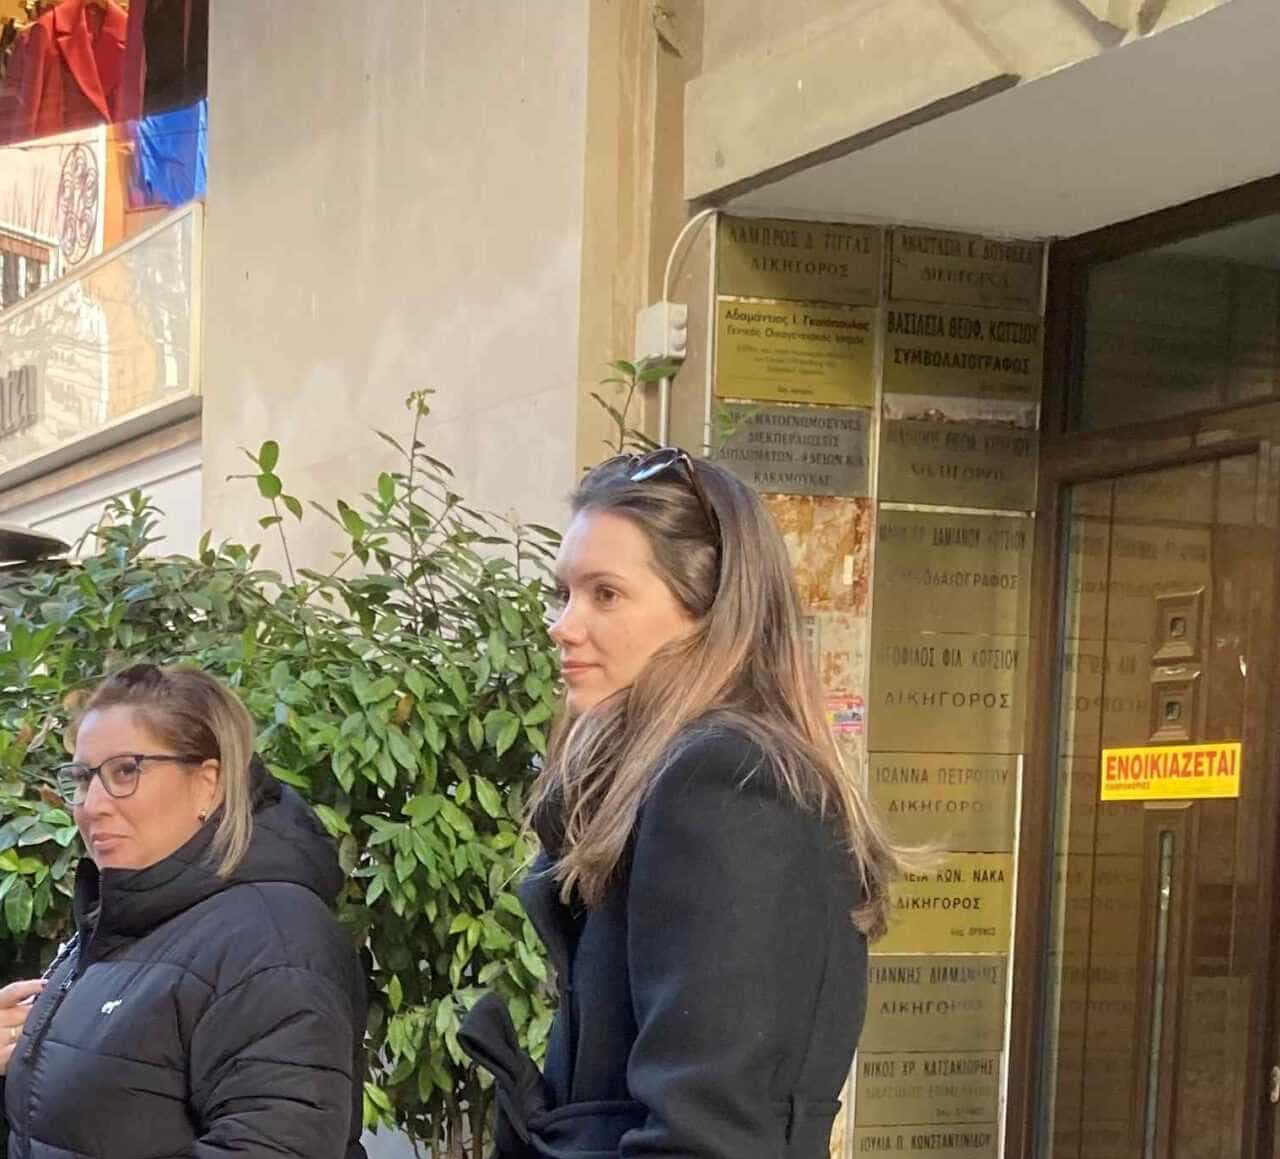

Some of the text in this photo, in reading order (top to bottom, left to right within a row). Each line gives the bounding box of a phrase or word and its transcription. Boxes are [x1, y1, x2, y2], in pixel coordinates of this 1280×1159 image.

[751, 256, 849, 278] ΔΙΚΗΓΟΡΟΣ
[724, 308, 788, 325] Αδαμάντιος
[893, 348, 1031, 375] ΣΥΜΒΟΛΑΙΟΓΡΑΦΟΣ
[884, 691, 1011, 709] ΔΙΚΗΓΟΡΟΣ
[1106, 750, 1236, 781] ΕΝΟΙΚΙΑΖΕΤΑΙ
[876, 768, 929, 784] ΙΩΑΝΝΑ
[888, 799, 988, 813] ΔΙΚΗΓΟΡΟ
[973, 870, 1005, 883] ΝΑΚΑ
[896, 897, 981, 910] ΔΙΚΗΓΟΡΟΣ
[871, 966, 922, 985] ΓΙΑΝΝΗΣ
[879, 1000, 985, 1016] ΔΙΚΗΓΟΡ
[863, 1060, 895, 1079] ΝΙΚΟΣ
[911, 1133, 992, 1151] ΚΩΝΣΤΑΝΤΙΝΙΔΟΥ
